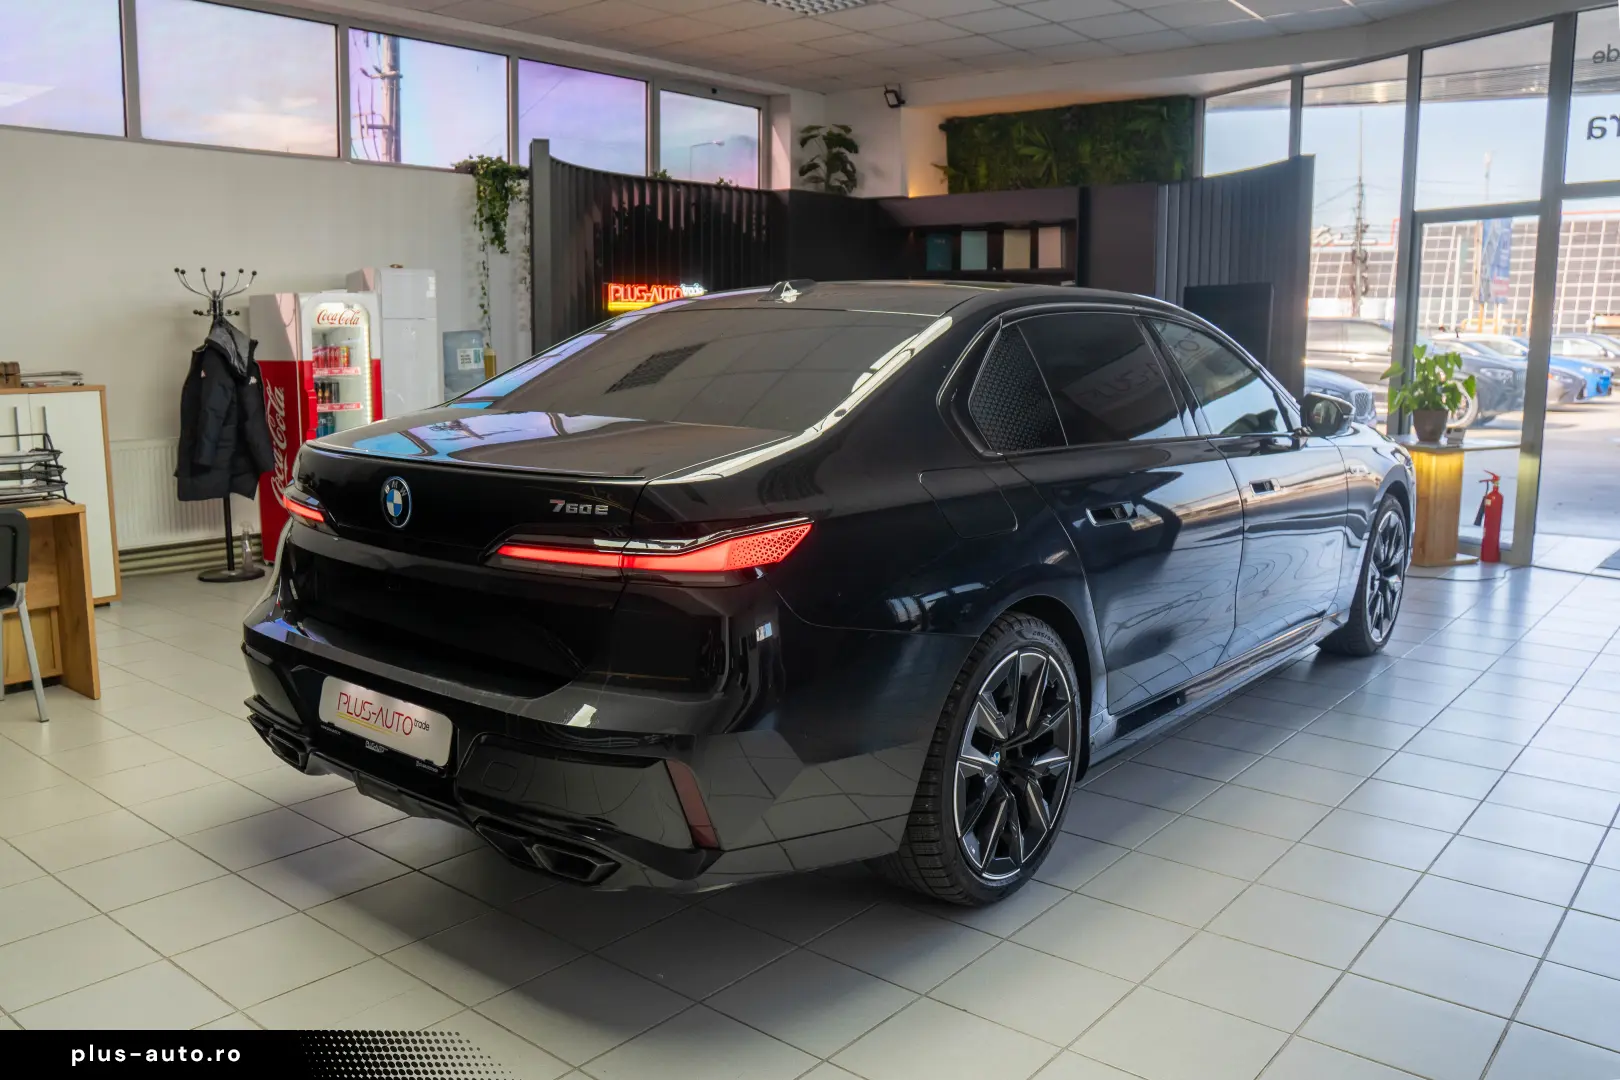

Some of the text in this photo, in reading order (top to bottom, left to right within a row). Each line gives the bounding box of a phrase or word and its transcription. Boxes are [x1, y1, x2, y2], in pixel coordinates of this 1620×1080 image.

[608, 283, 684, 303] PLUS-AUTO
[337, 691, 414, 736] PLUS-AUTO
[413, 718, 430, 731] trade
